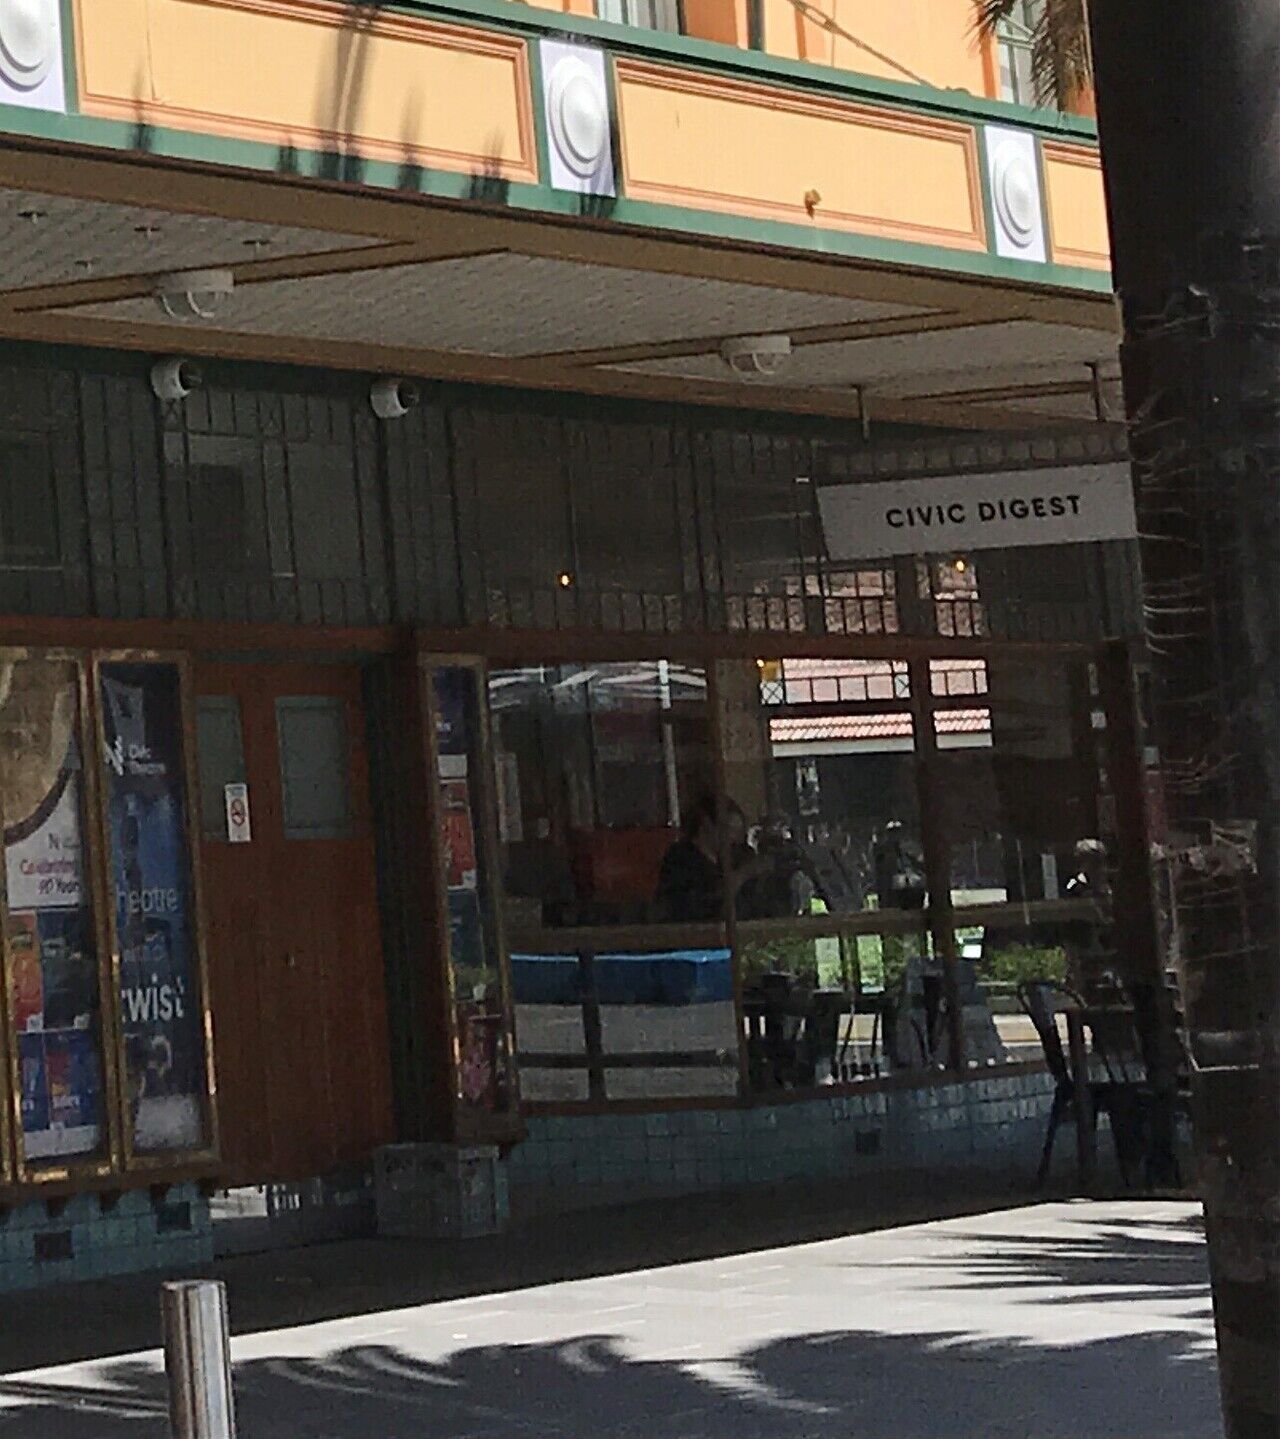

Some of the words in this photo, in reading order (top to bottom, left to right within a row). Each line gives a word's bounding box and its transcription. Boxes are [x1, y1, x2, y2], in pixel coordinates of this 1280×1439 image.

[886, 503, 965, 528] CIVIC
[978, 494, 1080, 522] DIGEST
[117, 882, 178, 913] heatre
